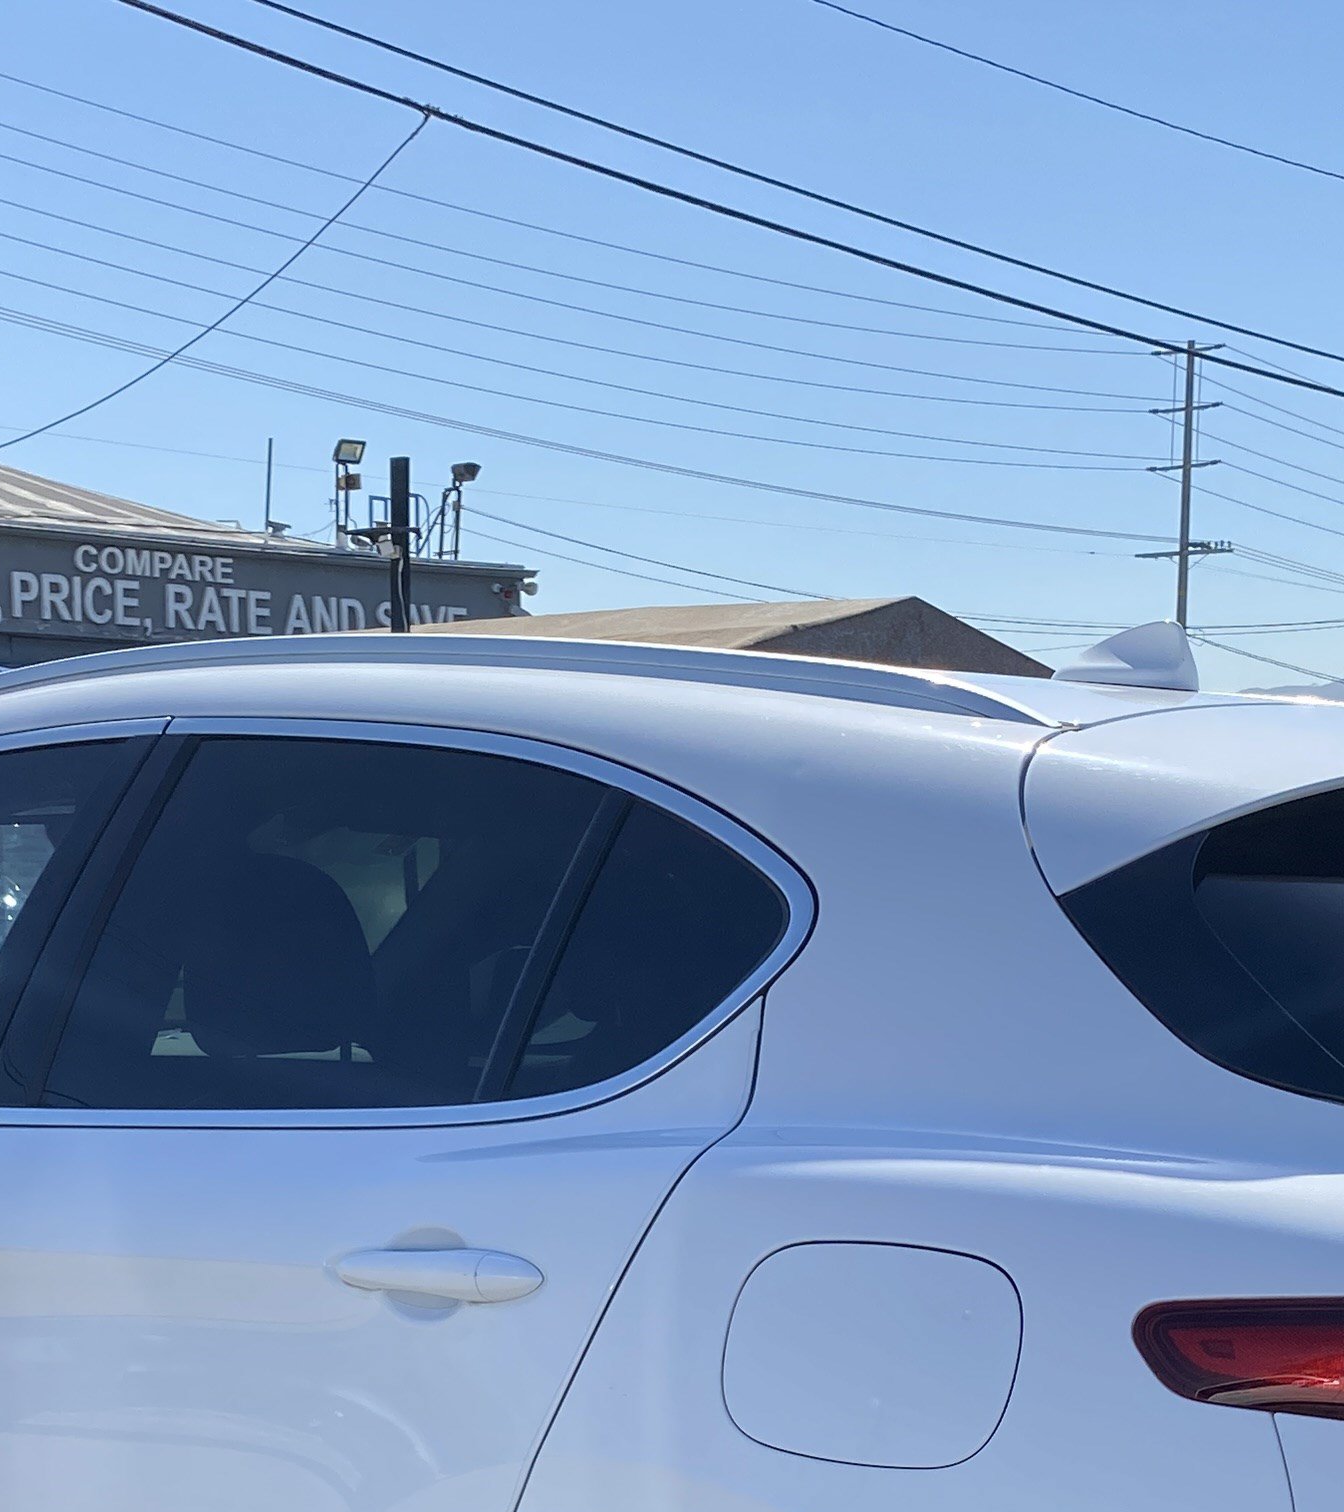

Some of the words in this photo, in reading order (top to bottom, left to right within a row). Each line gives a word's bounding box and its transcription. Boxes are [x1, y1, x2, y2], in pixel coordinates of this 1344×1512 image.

[74, 544, 234, 585] COMPARE
[10, 571, 153, 637] PRICE,
[164, 583, 273, 636] RATE
[285, 593, 365, 635] AND
